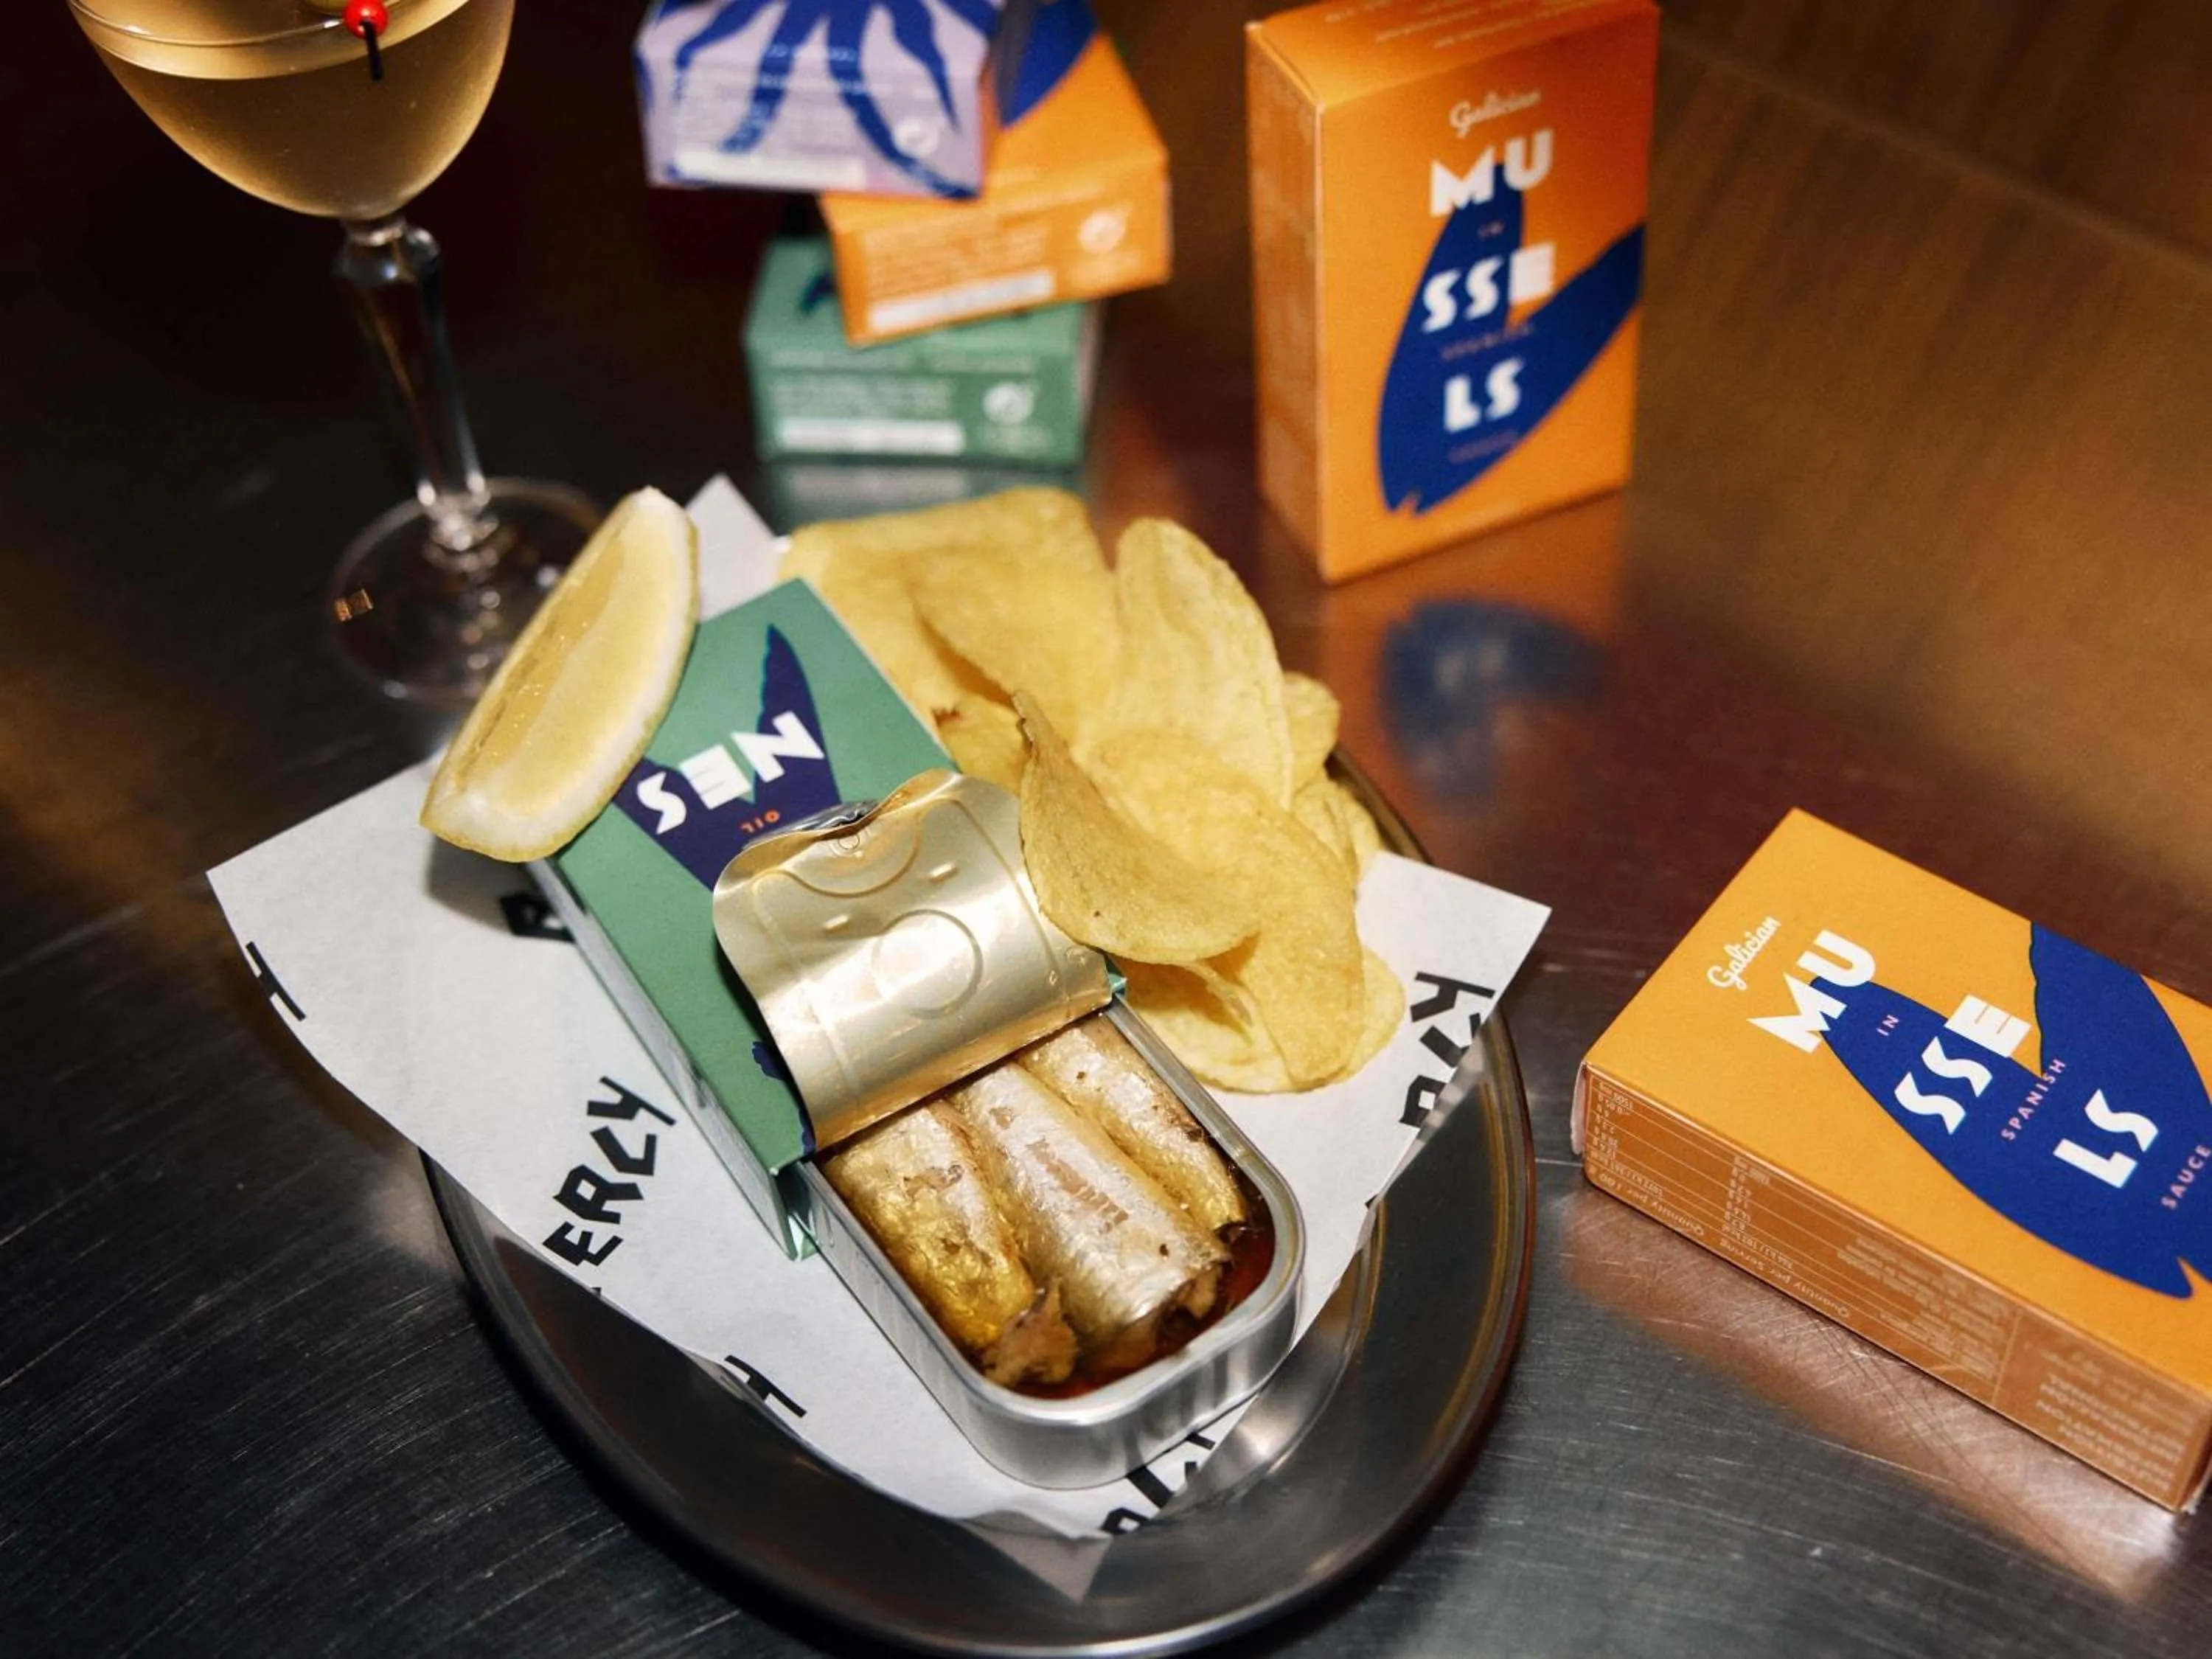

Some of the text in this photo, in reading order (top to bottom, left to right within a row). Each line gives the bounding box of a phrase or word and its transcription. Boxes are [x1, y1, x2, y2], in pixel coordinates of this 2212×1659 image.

[1431, 128, 1554, 215] MU
[1444, 357, 1523, 433] LS
[740, 810, 779, 832] OIL
[1707, 916, 1781, 990] Galician
[1745, 929, 1876, 1054] MU
[1877, 1015, 1899, 1036] IN
[1894, 994, 2032, 1135] SSE
[2001, 1058, 2066, 1141] SPANISH
[2053, 1088, 2159, 1189] LS
[542, 1076, 676, 1295] ERCY
[1599, 1174, 1621, 1189] 100
[1628, 1189, 1648, 1203] per
[2161, 1144, 2212, 1210] SAUCE
[1653, 1200, 1704, 1237] Quantity
[1719, 1239, 1849, 1317] Quantity per Serving
